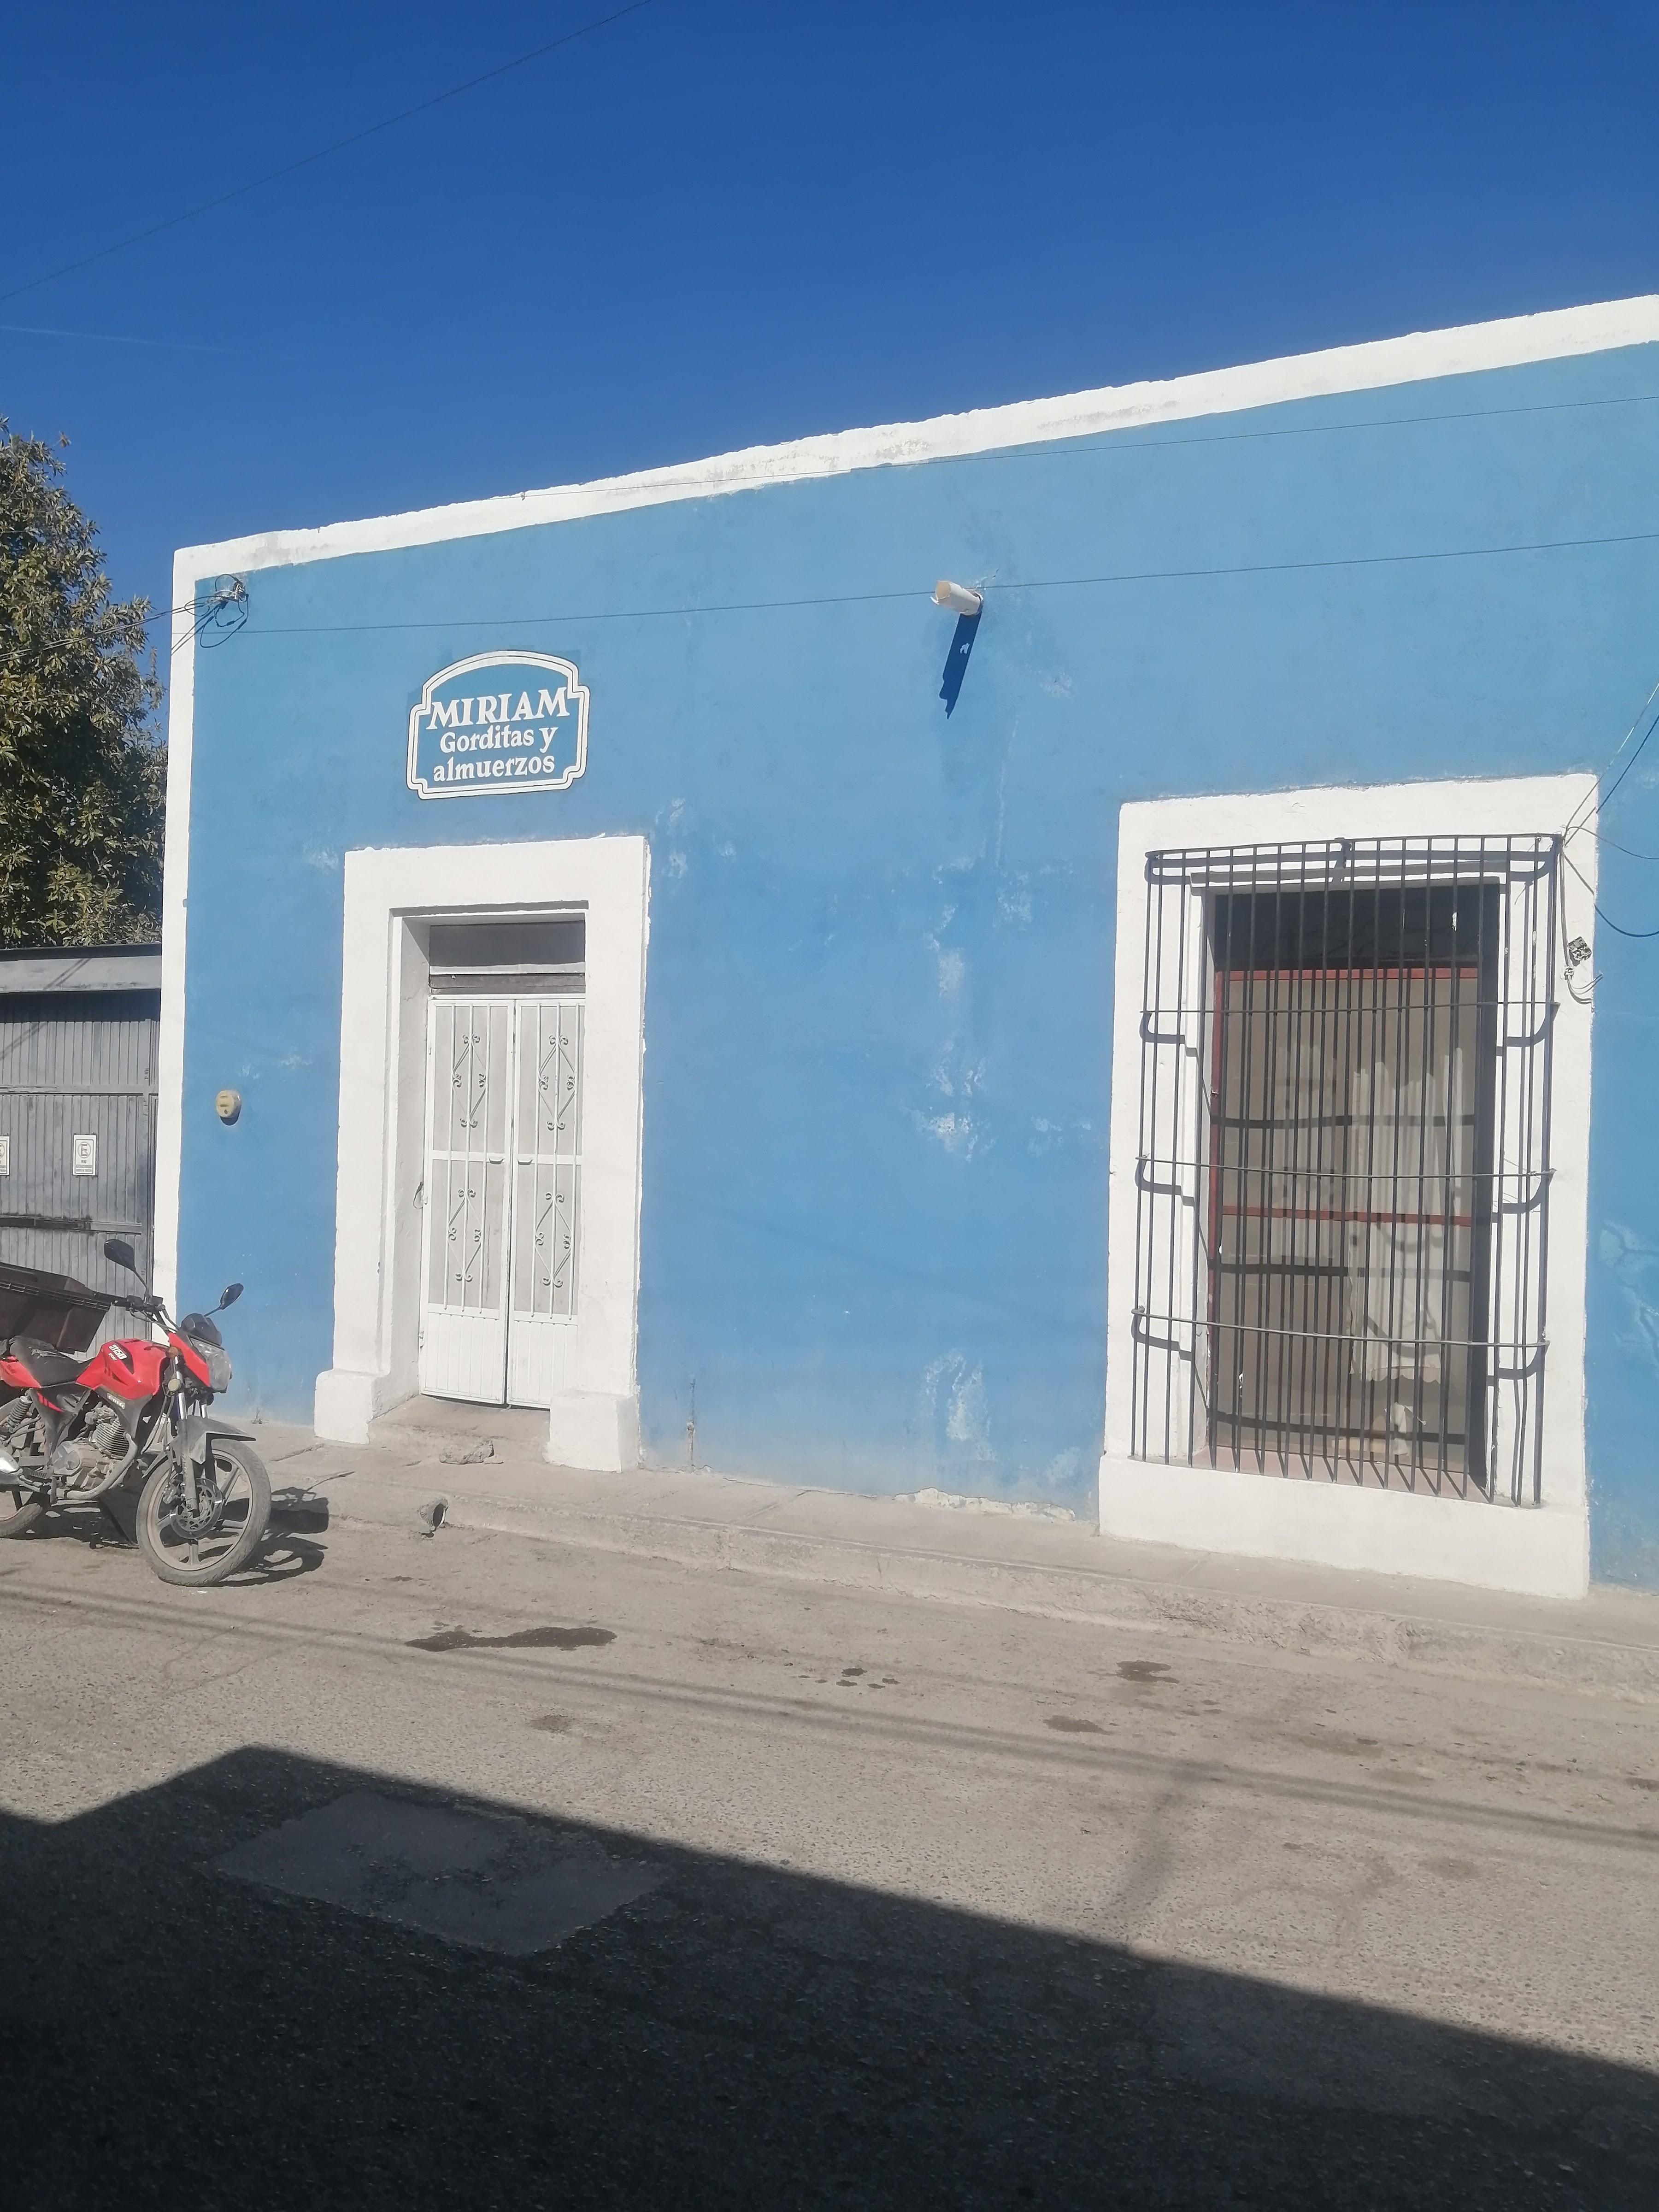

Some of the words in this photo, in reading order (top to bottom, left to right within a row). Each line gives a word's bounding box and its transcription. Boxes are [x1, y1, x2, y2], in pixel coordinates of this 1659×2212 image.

[425, 687, 571, 730] MIRIAM
[440, 725, 534, 753] Gorditas
[538, 727, 559, 753] y
[433, 755, 555, 782] almuerzos
